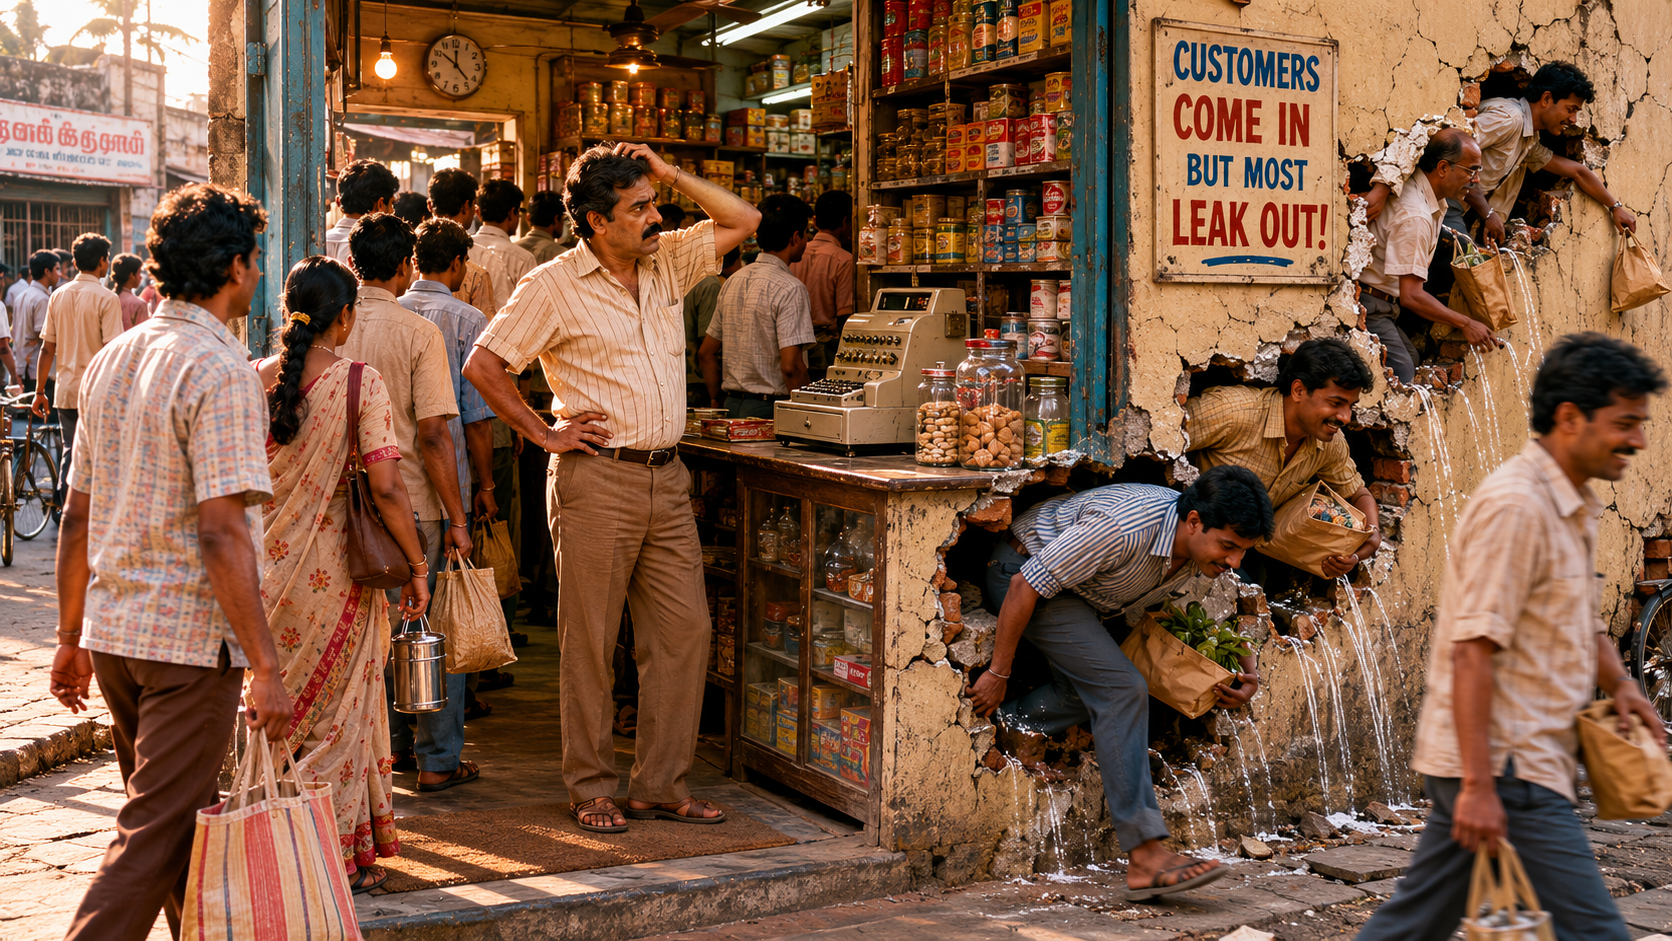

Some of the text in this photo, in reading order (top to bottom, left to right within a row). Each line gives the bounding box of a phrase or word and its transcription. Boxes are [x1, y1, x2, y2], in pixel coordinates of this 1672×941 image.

[465, 43, 469, 51] 1
[472, 52, 478, 60] 2
[474, 63, 481, 71] 3
[1173, 40, 1320, 92] CUSTOMERS
[443, 81, 449, 89] 7
[453, 84, 459, 93] 6
[464, 82, 470, 91] 5
[1173, 93, 1310, 147] COME IN
[1187, 153, 1308, 191] BUT MOST
[1172, 198, 1328, 250] LEAK OUT!
